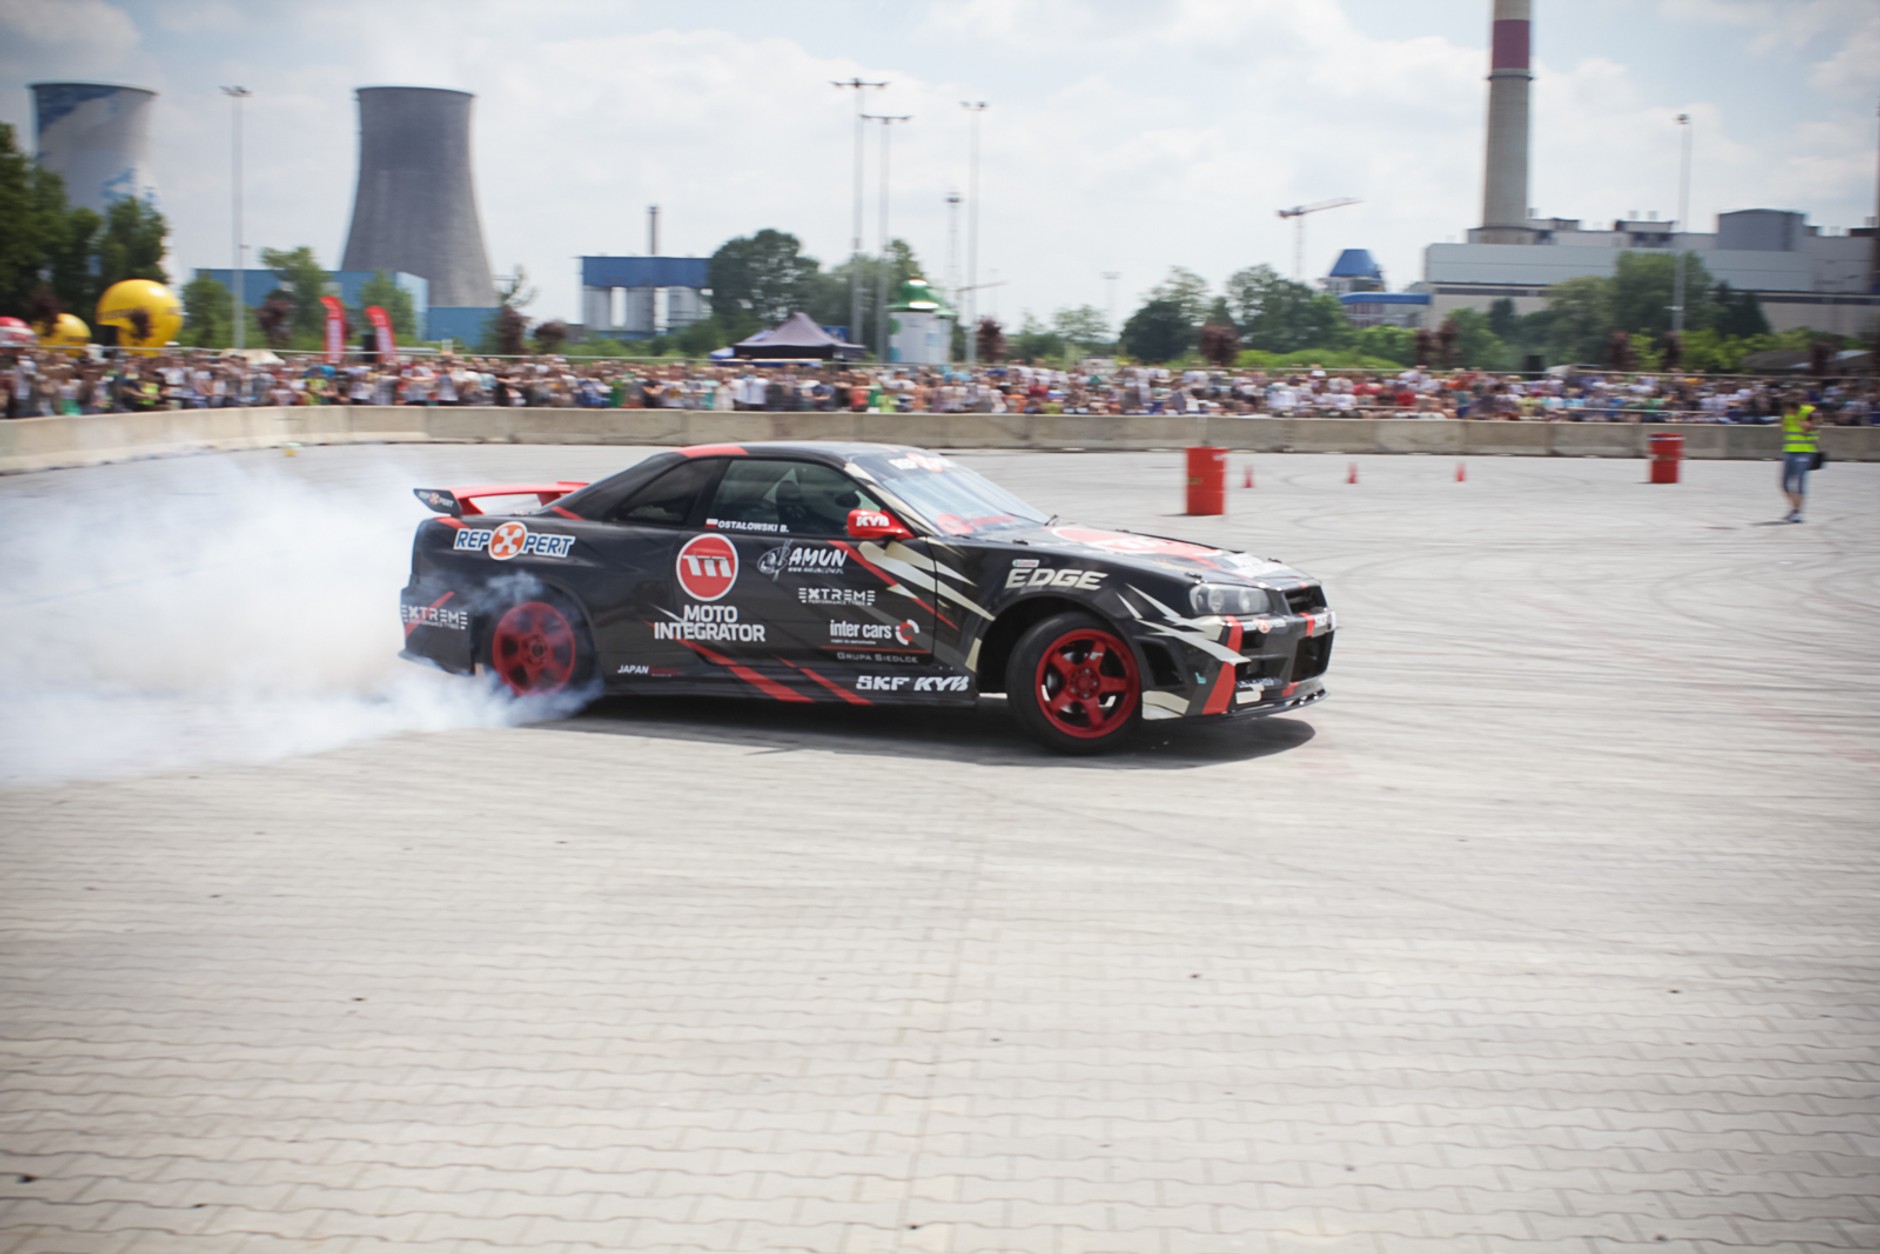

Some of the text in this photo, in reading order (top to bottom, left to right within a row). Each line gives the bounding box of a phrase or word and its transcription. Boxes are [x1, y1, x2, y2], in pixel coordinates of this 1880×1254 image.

[779, 524, 790, 533] B.
[856, 516, 890, 527] KYB
[454, 521, 576, 560] REPXPERT
[788, 547, 848, 567] AMUN
[1005, 568, 1109, 591] EDGE
[798, 587, 875, 606] EXTREME
[400, 604, 468, 630] EXTREME
[684, 604, 738, 624] MOTO
[654, 621, 766, 642] INTEGRATOR
[830, 619, 892, 639] inter cars
[617, 665, 649, 675] JAPAN
[856, 675, 969, 692] SKF KYB
